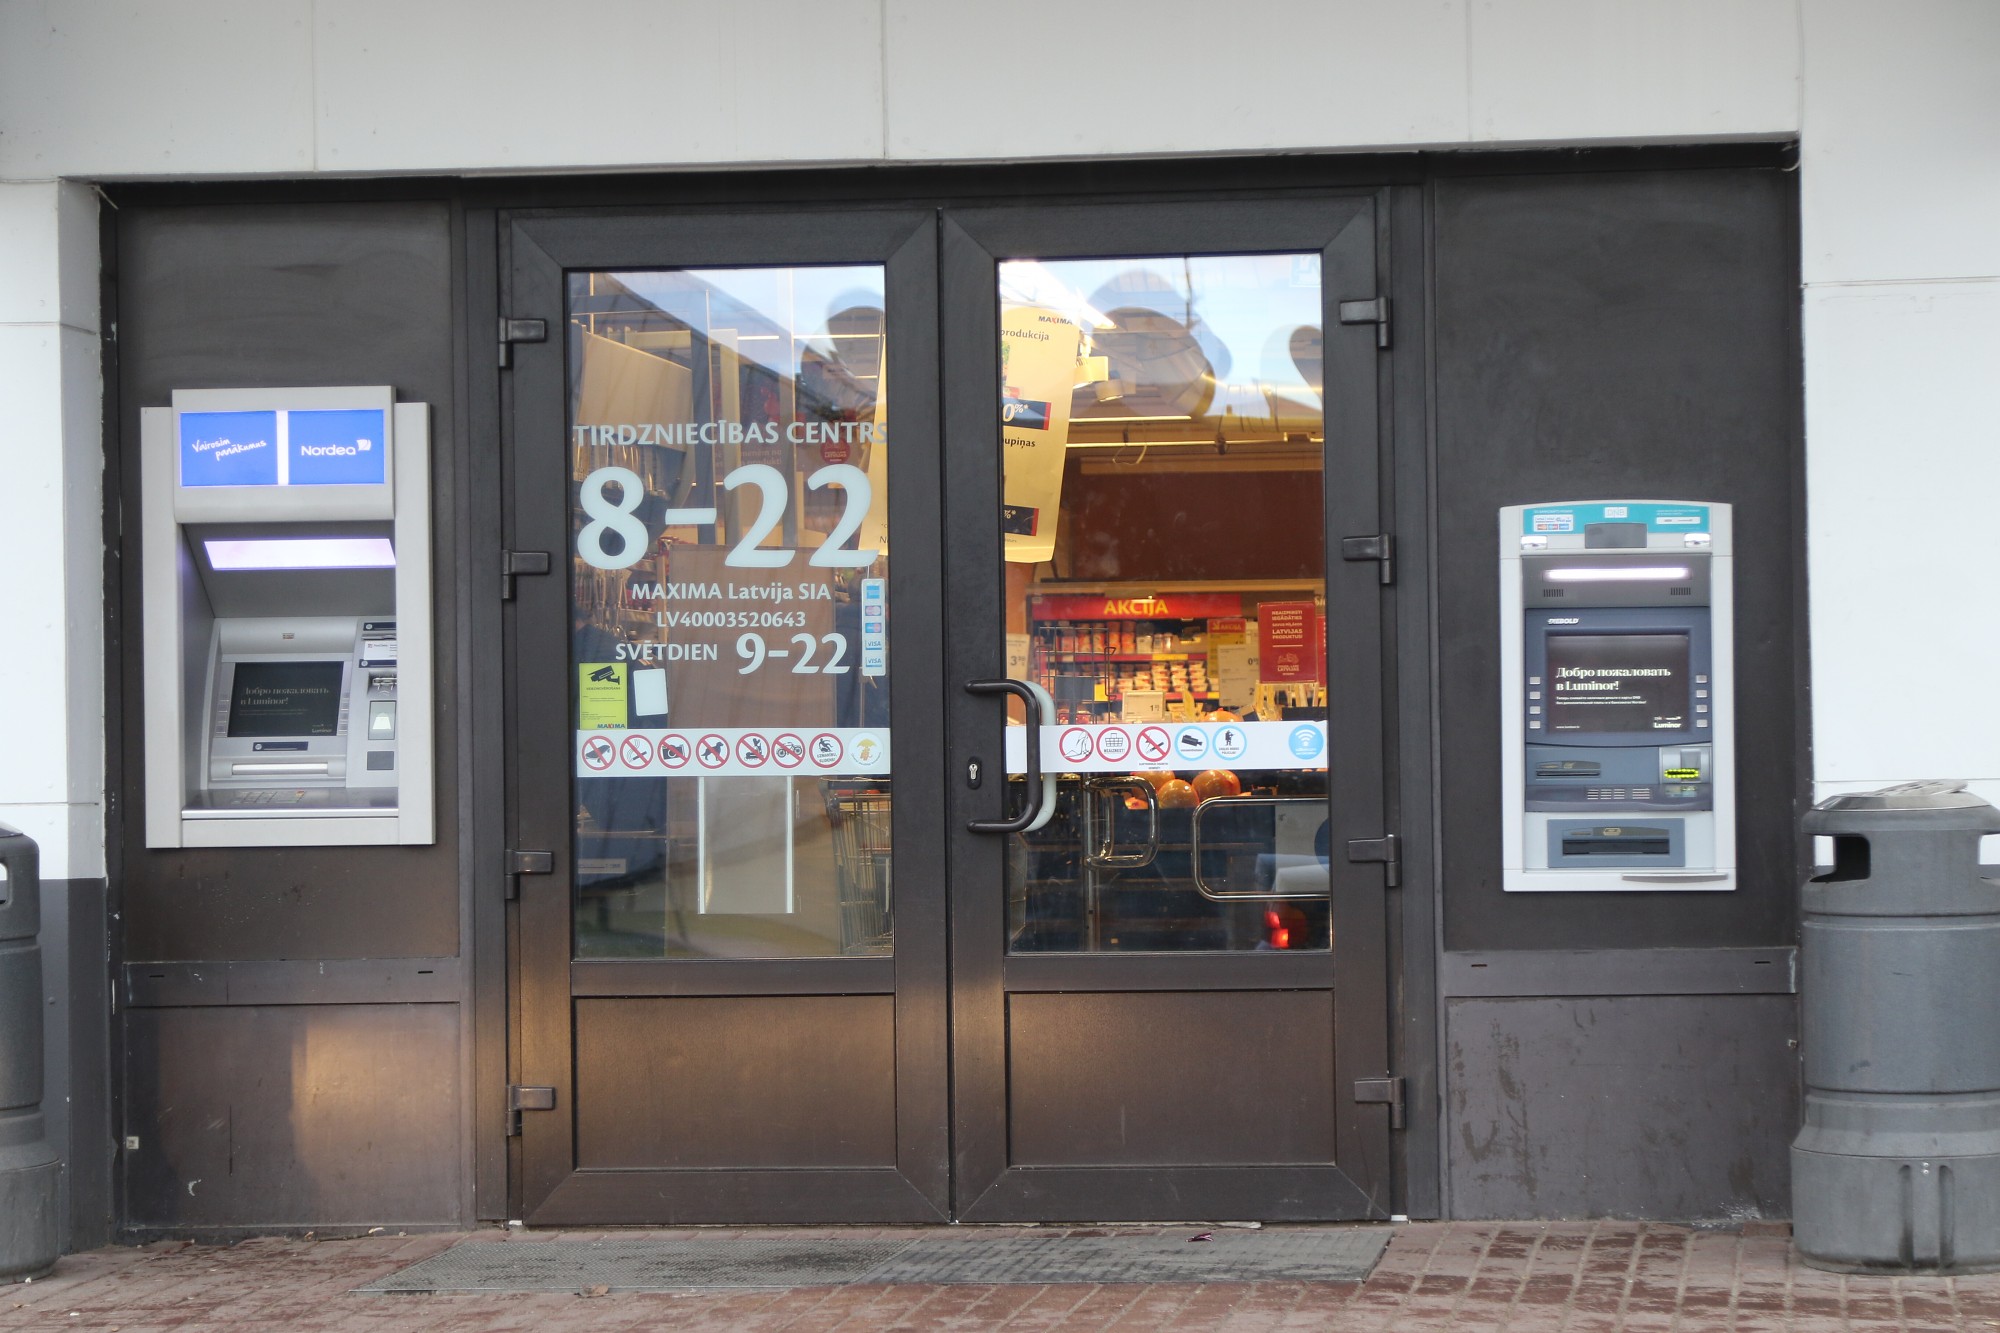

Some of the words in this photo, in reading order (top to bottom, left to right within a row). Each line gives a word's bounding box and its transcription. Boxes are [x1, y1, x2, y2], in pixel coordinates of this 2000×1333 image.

[1038, 315, 1073, 325] MAXIMA
[572, 419, 779, 446] TIRDZNIECĪBAS
[786, 420, 888, 445] CENTRS
[215, 440, 267, 461] panākumus
[301, 444, 356, 456] Nordea
[1001, 436, 1036, 449] upiņas
[577, 463, 880, 570] 8-22
[631, 583, 723, 600] MAXIMA
[728, 582, 794, 605] Latvija
[798, 582, 832, 600] SIA
[1103, 599, 1169, 617] AKCIJA
[656, 611, 807, 628] LV40003520643
[615, 640, 718, 661] SVĒTDIEN
[735, 632, 851, 675] 9-22
[1555, 667, 1596, 679] Добро
[1597, 668, 1672, 677] пожаловать
[1556, 682, 1564, 691] в
[1565, 681, 1620, 691] Luminor!
